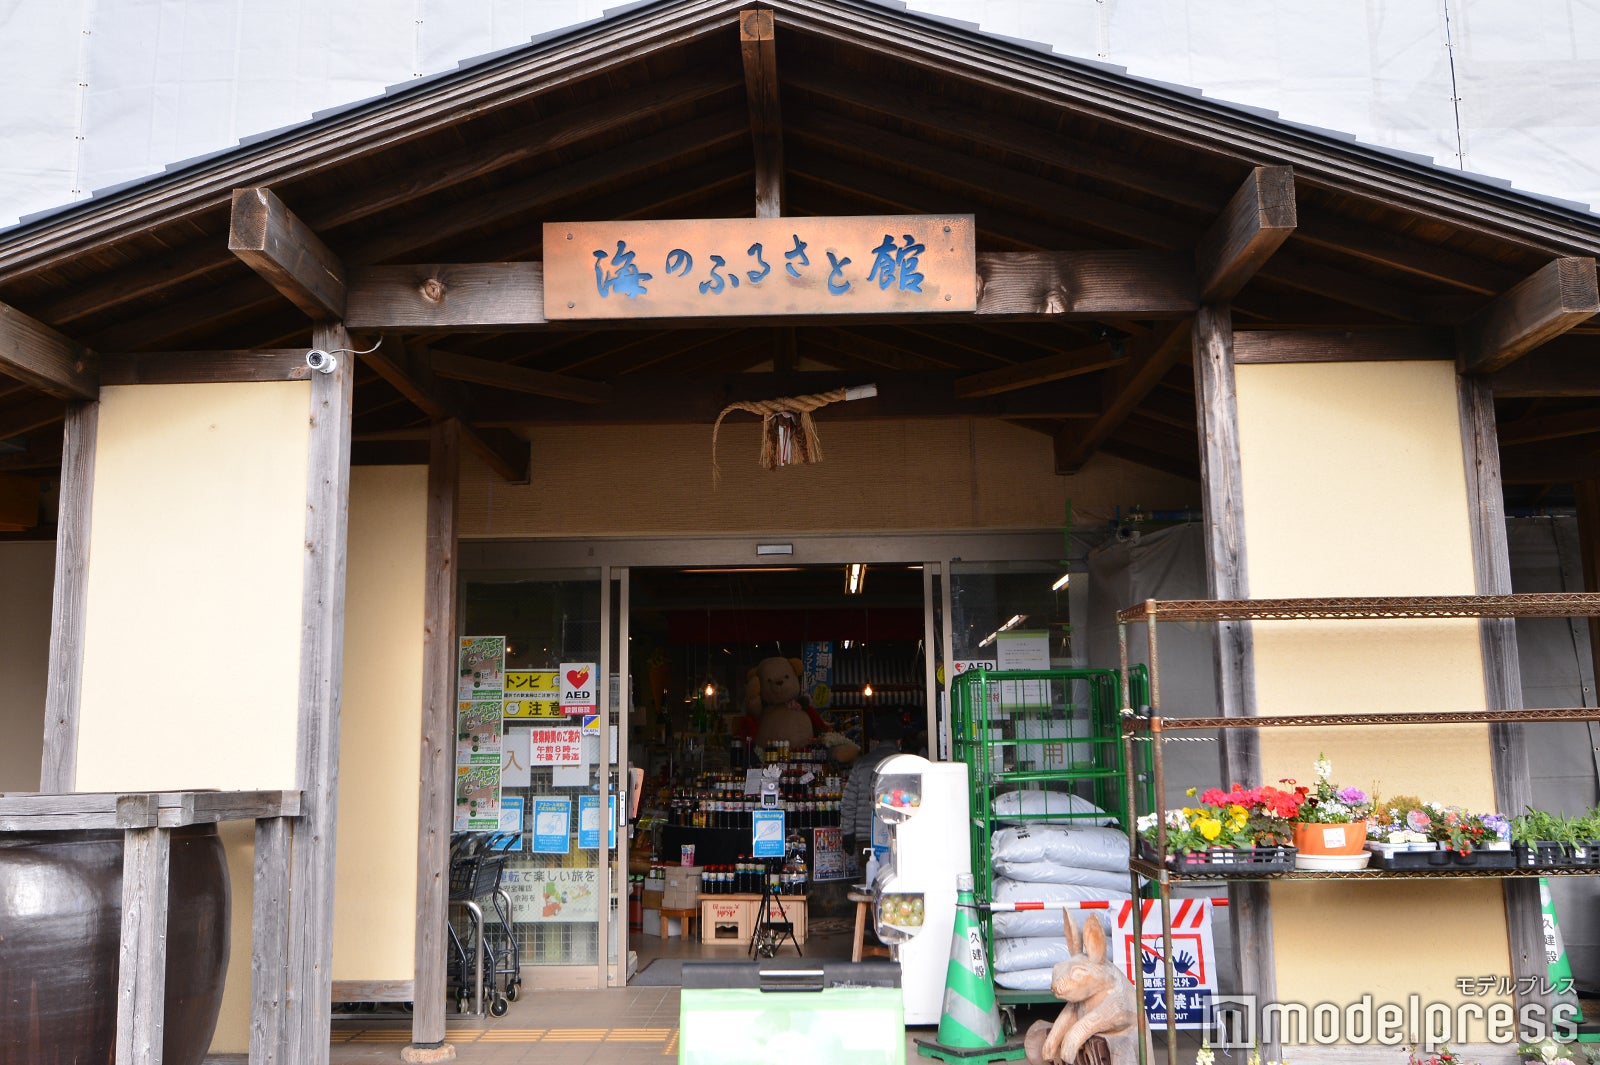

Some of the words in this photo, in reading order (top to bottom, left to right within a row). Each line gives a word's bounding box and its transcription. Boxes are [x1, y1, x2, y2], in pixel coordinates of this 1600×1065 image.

[593, 234, 925, 299] 海のふるさと館
[506, 675, 541, 688] トンビ
[566, 691, 590, 699] AED
[533, 730, 580, 743] 営業時間のご案内
[502, 751, 523, 771] 入
[1144, 993, 1206, 1010] 入禁止
